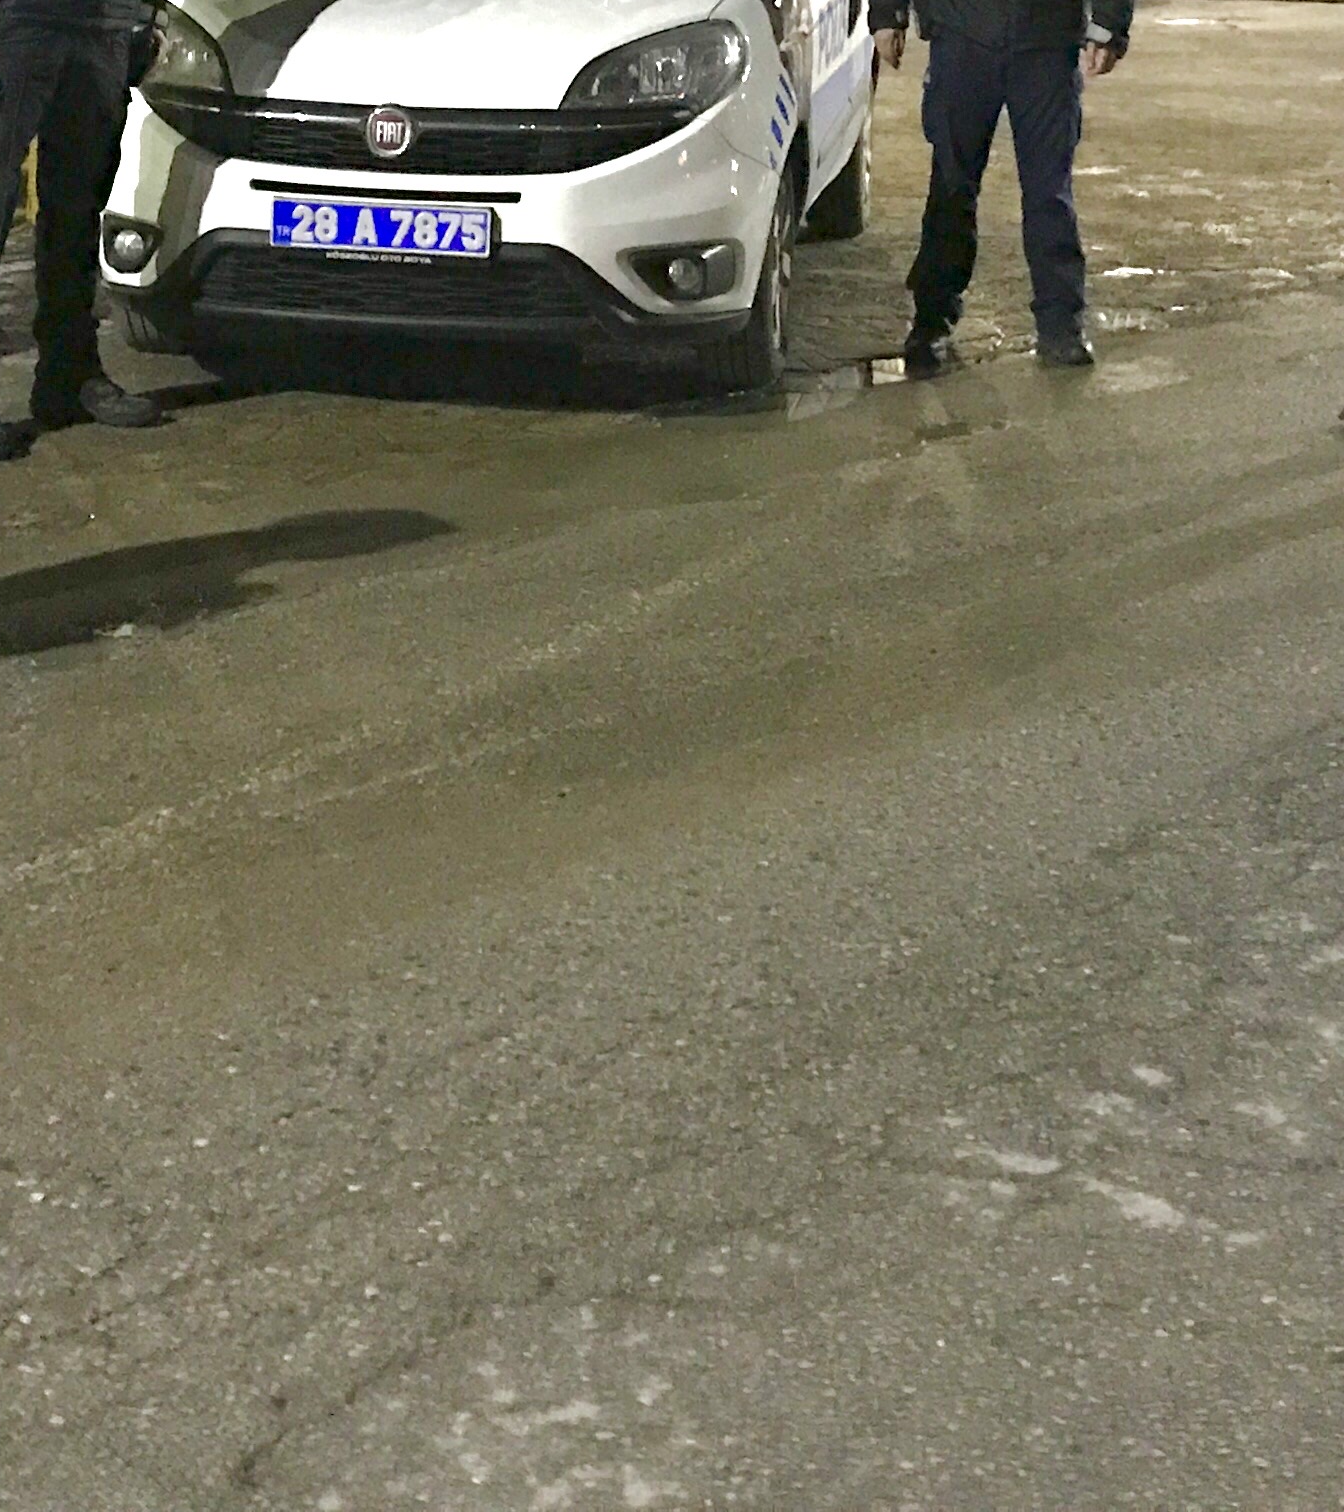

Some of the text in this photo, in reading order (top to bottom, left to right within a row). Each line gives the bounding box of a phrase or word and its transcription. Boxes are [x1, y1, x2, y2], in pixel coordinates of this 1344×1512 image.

[376, 121, 404, 144] FIAT
[291, 204, 486, 251] 28 A 7875
